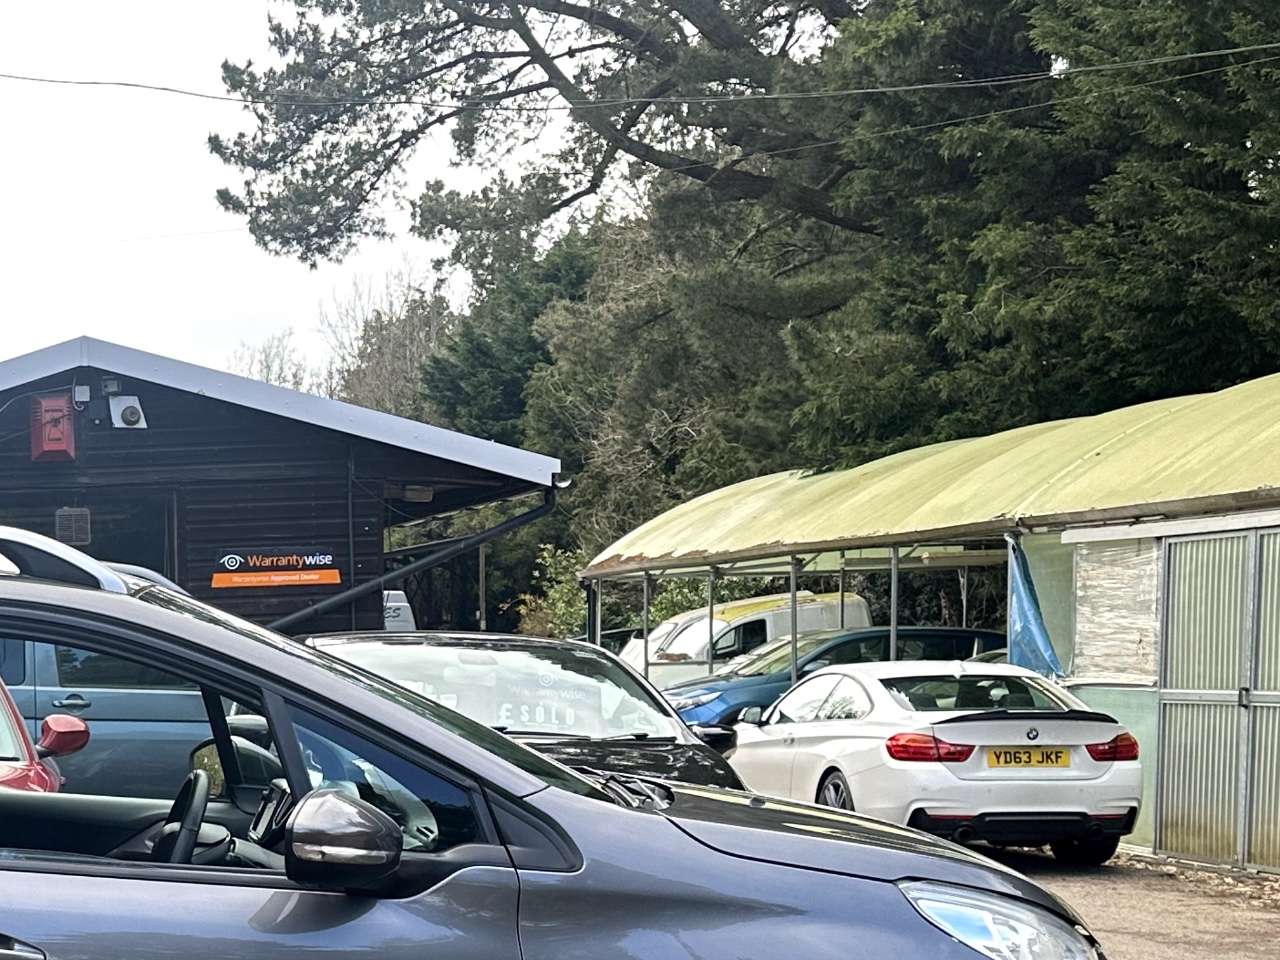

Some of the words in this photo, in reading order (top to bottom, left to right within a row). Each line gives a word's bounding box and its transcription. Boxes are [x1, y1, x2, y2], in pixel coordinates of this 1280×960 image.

[248, 552, 333, 569] Warrantywise
[993, 750, 1032, 764] YD63
[1036, 750, 1064, 764] JKF
